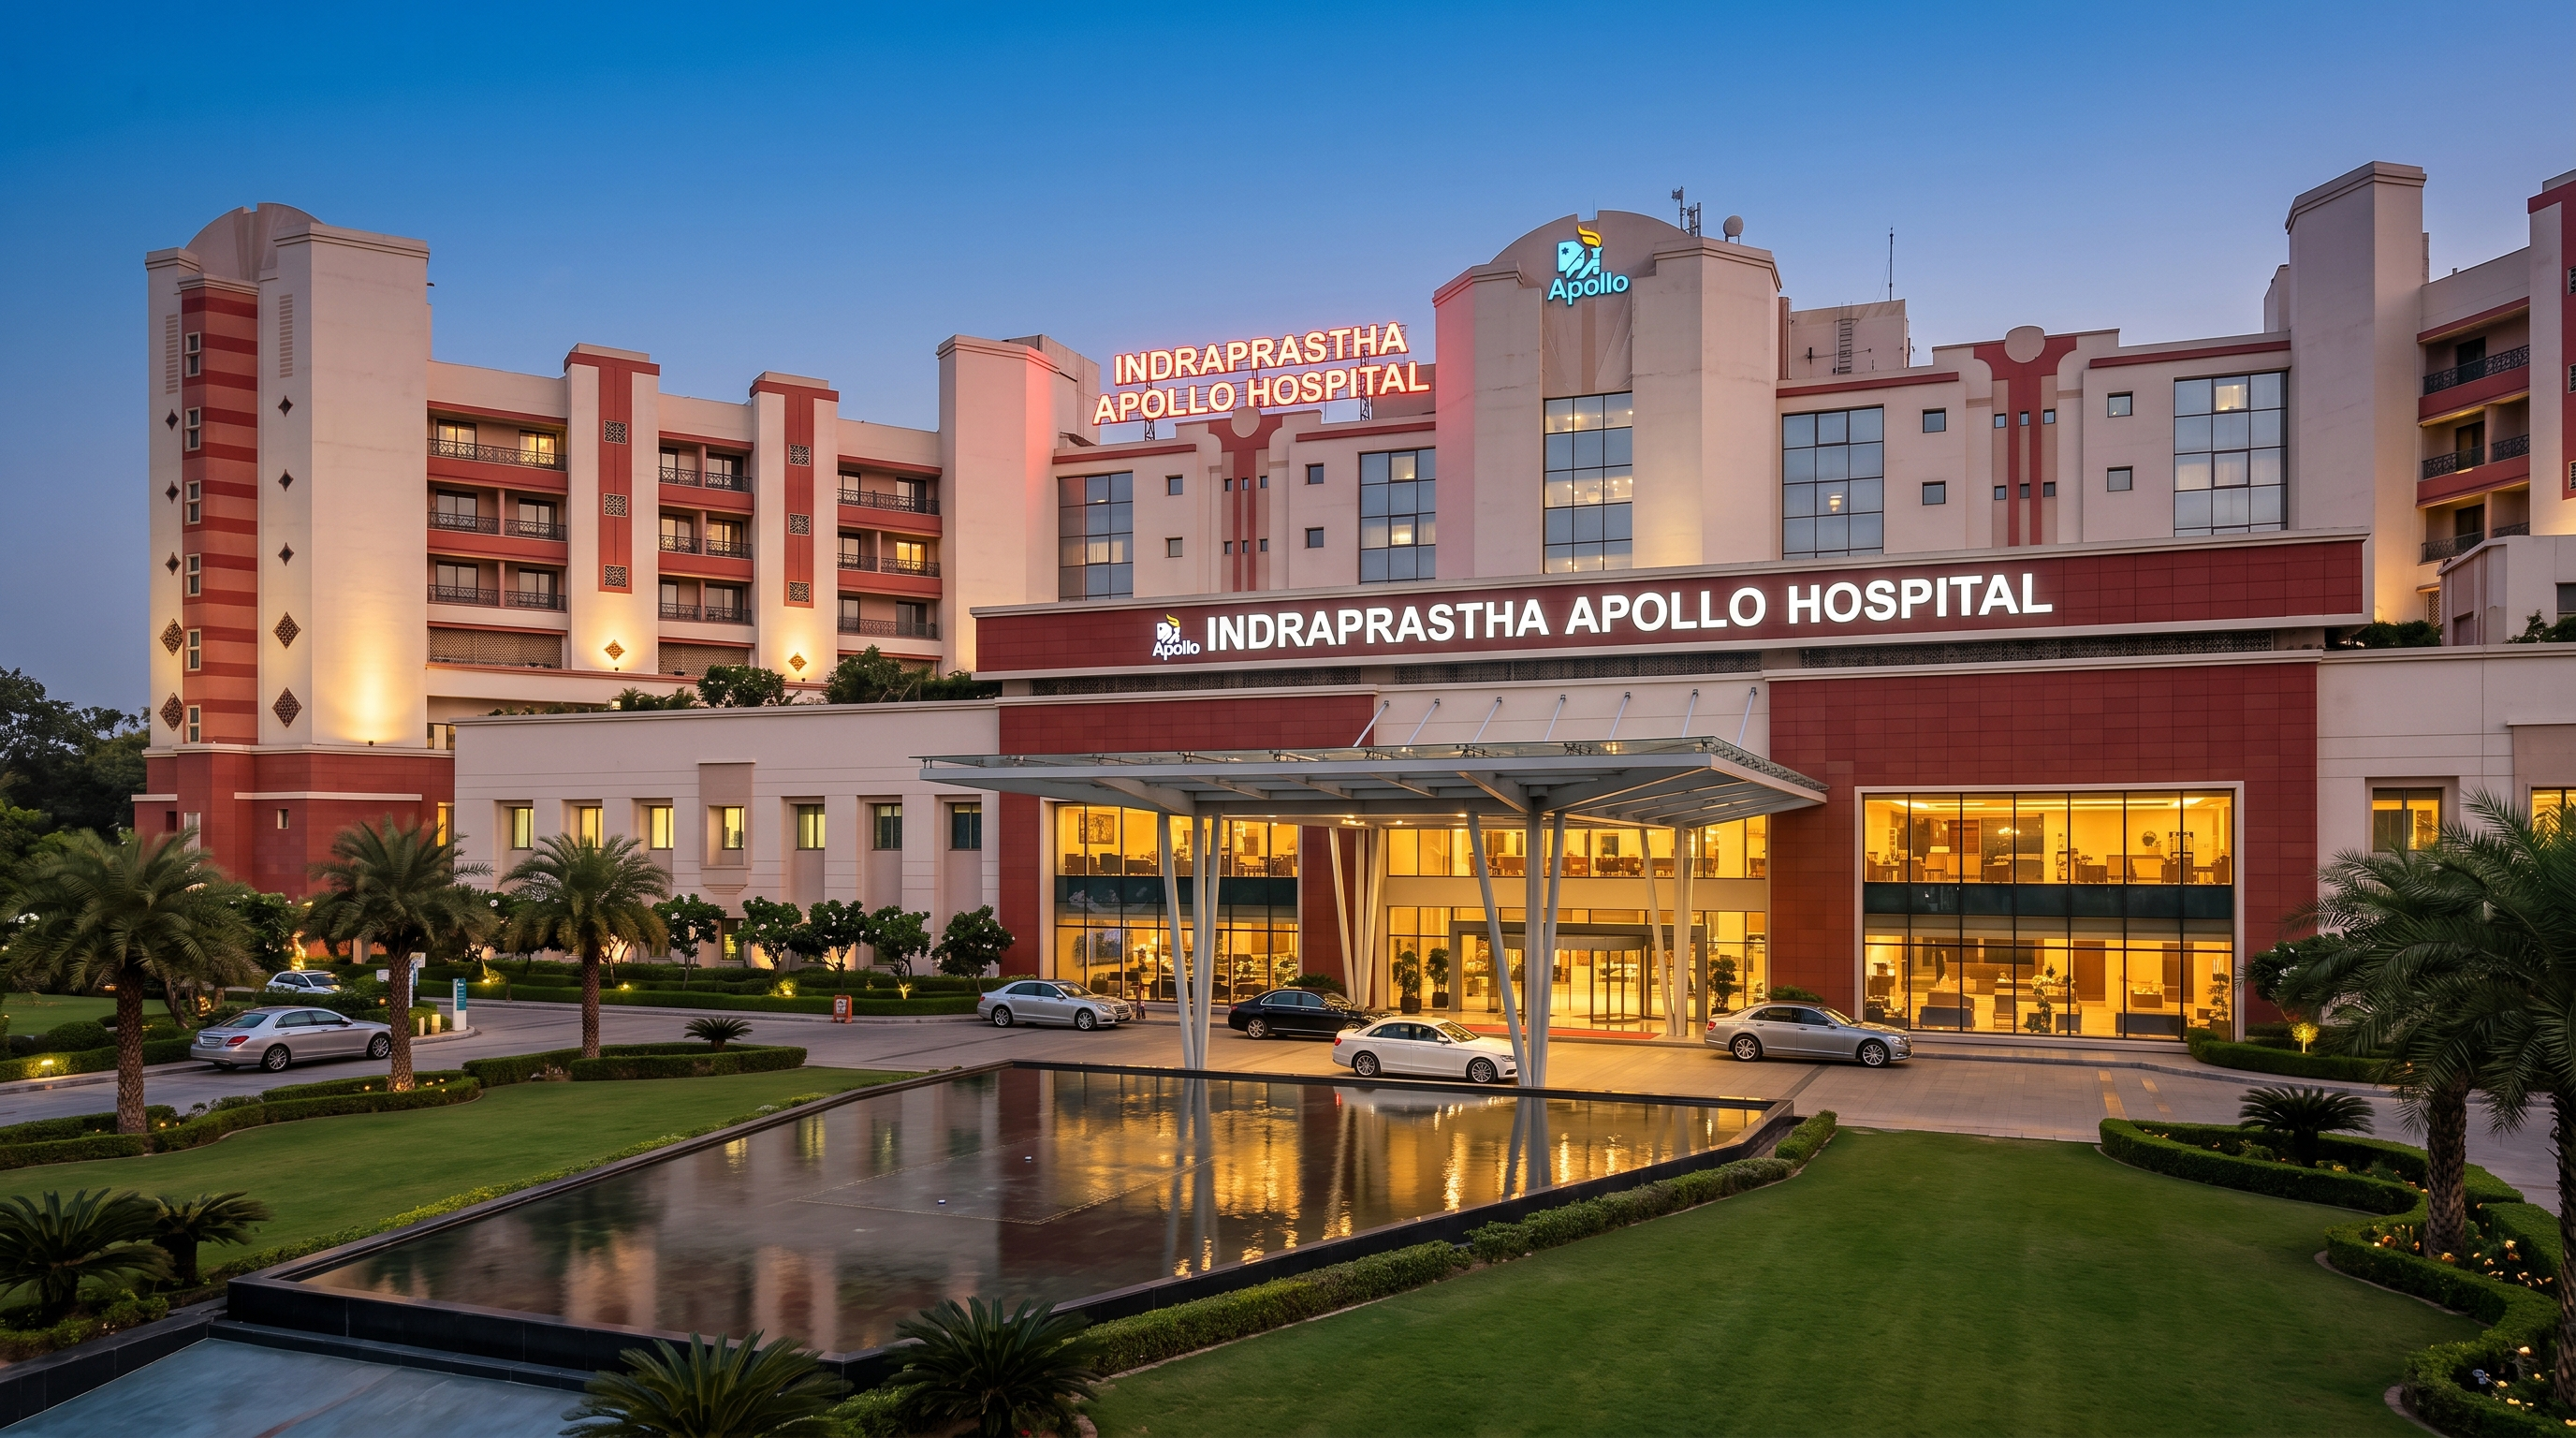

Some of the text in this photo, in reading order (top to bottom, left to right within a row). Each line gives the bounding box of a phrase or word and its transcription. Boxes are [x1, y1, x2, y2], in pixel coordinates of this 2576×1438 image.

[1547, 271, 1630, 305] Apollo
[1115, 321, 1409, 386] INDRAPRASTHA
[1092, 361, 1430, 425] APOLLO HOSPITAL
[1208, 573, 2053, 651] INDRAPRASTHA APOLLO HOSPITAL
[1152, 639, 1200, 660] Apollo
